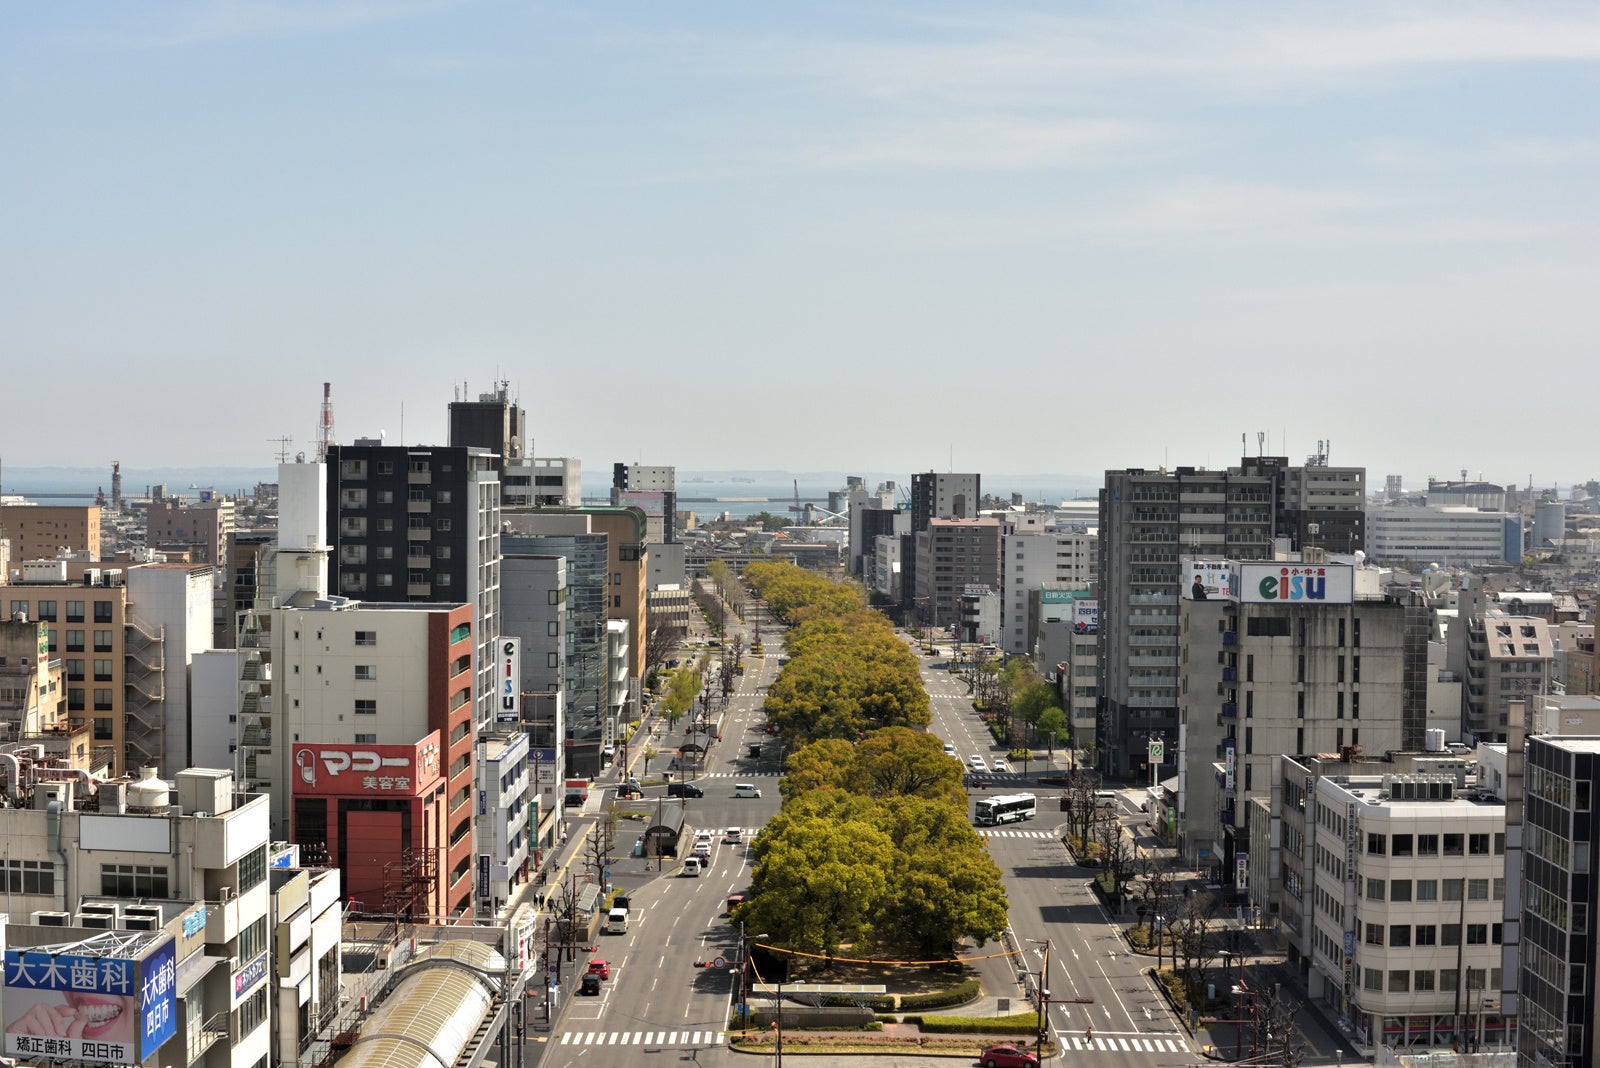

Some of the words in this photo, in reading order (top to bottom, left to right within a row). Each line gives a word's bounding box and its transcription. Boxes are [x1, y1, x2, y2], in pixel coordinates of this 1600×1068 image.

[1045, 591, 1073, 599] 日新火災
[1258, 567, 1326, 600] eisu
[502, 641, 515, 710] eisu
[320, 750, 410, 776] マコー
[363, 775, 411, 791] 美容室
[8, 956, 131, 994] 大木歯科
[141, 956, 175, 1011] 大木歯科
[146, 997, 169, 1037] 四日市
[16, 1036, 72, 1056] 矯正歯科
[82, 1043, 124, 1060] 四日市
